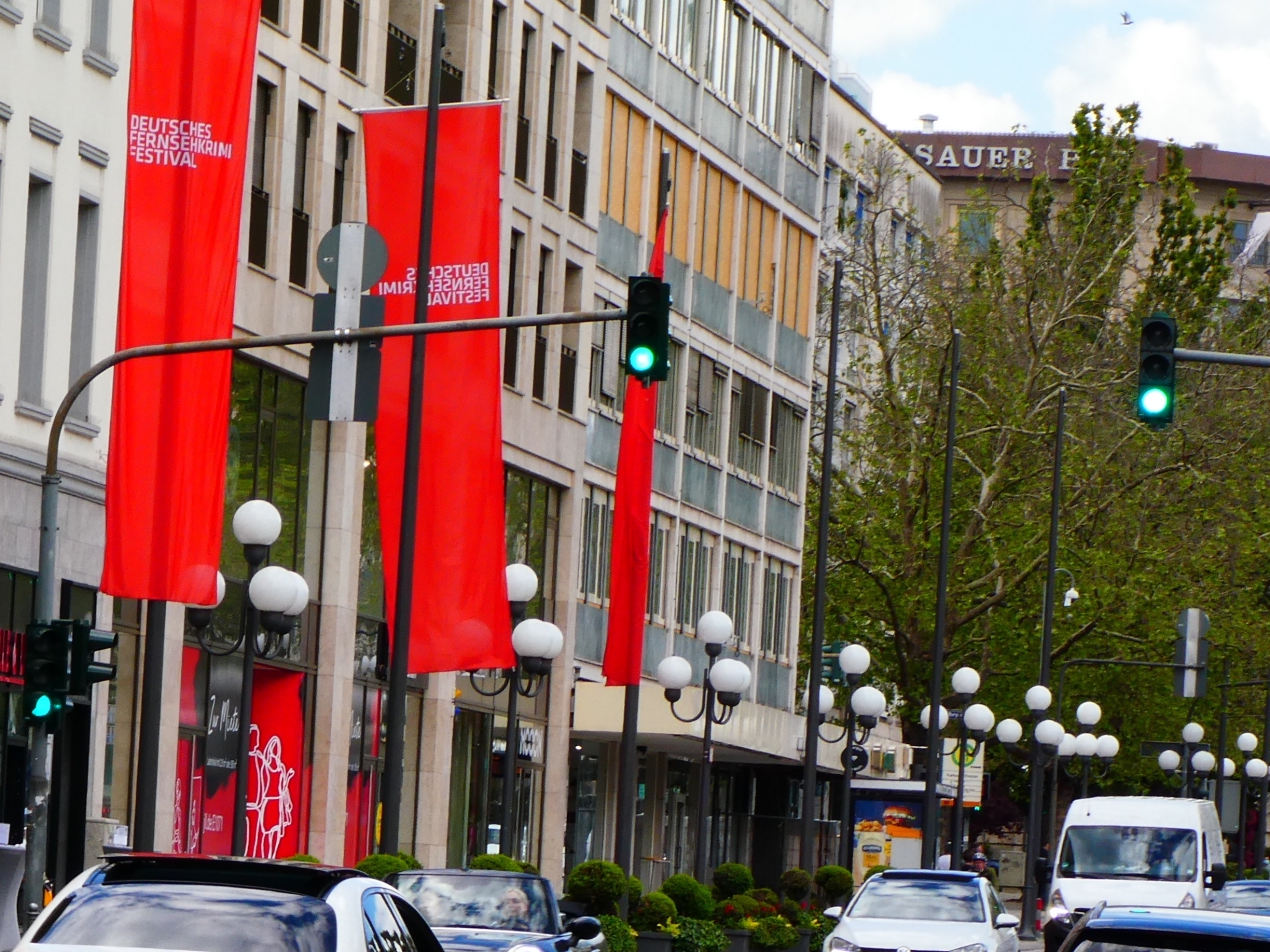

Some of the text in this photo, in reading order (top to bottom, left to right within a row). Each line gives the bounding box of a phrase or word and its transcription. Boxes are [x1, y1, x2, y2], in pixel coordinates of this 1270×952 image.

[131, 114, 212, 140] DEUTSCHES
[130, 131, 233, 159] FERNSEHKRIMI
[130, 146, 197, 169] FESTIVAL
